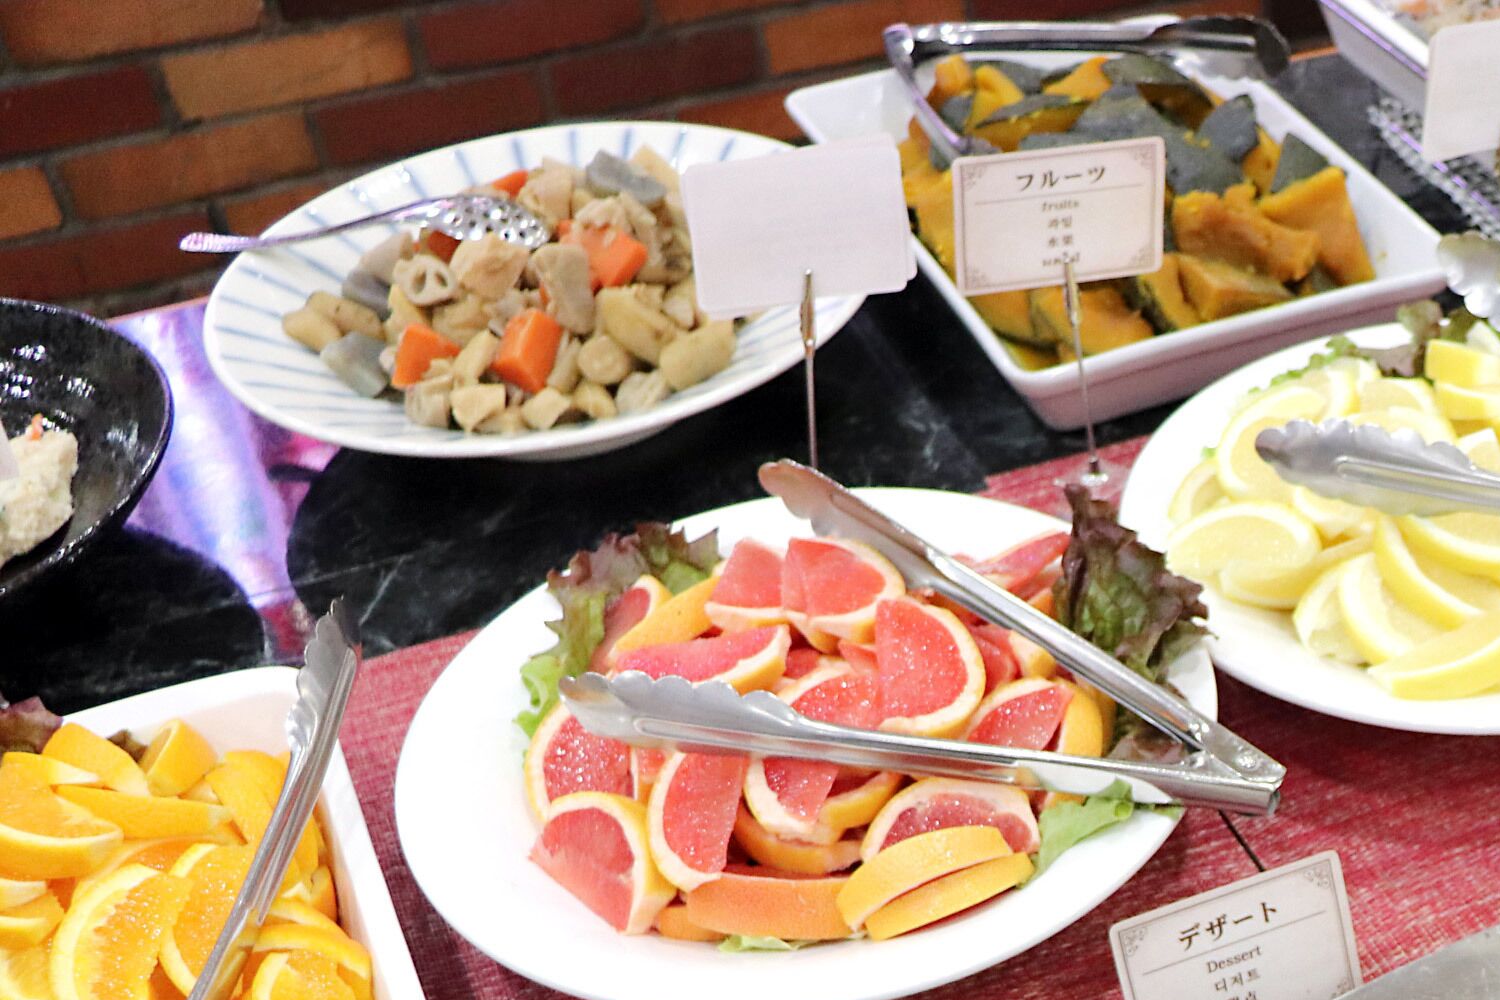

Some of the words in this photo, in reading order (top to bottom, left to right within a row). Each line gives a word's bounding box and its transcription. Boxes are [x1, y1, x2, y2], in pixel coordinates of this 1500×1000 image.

[1016, 165, 1106, 192] フルーツ
[1178, 901, 1277, 950] デザート
[1206, 945, 1262, 974] Dessert
